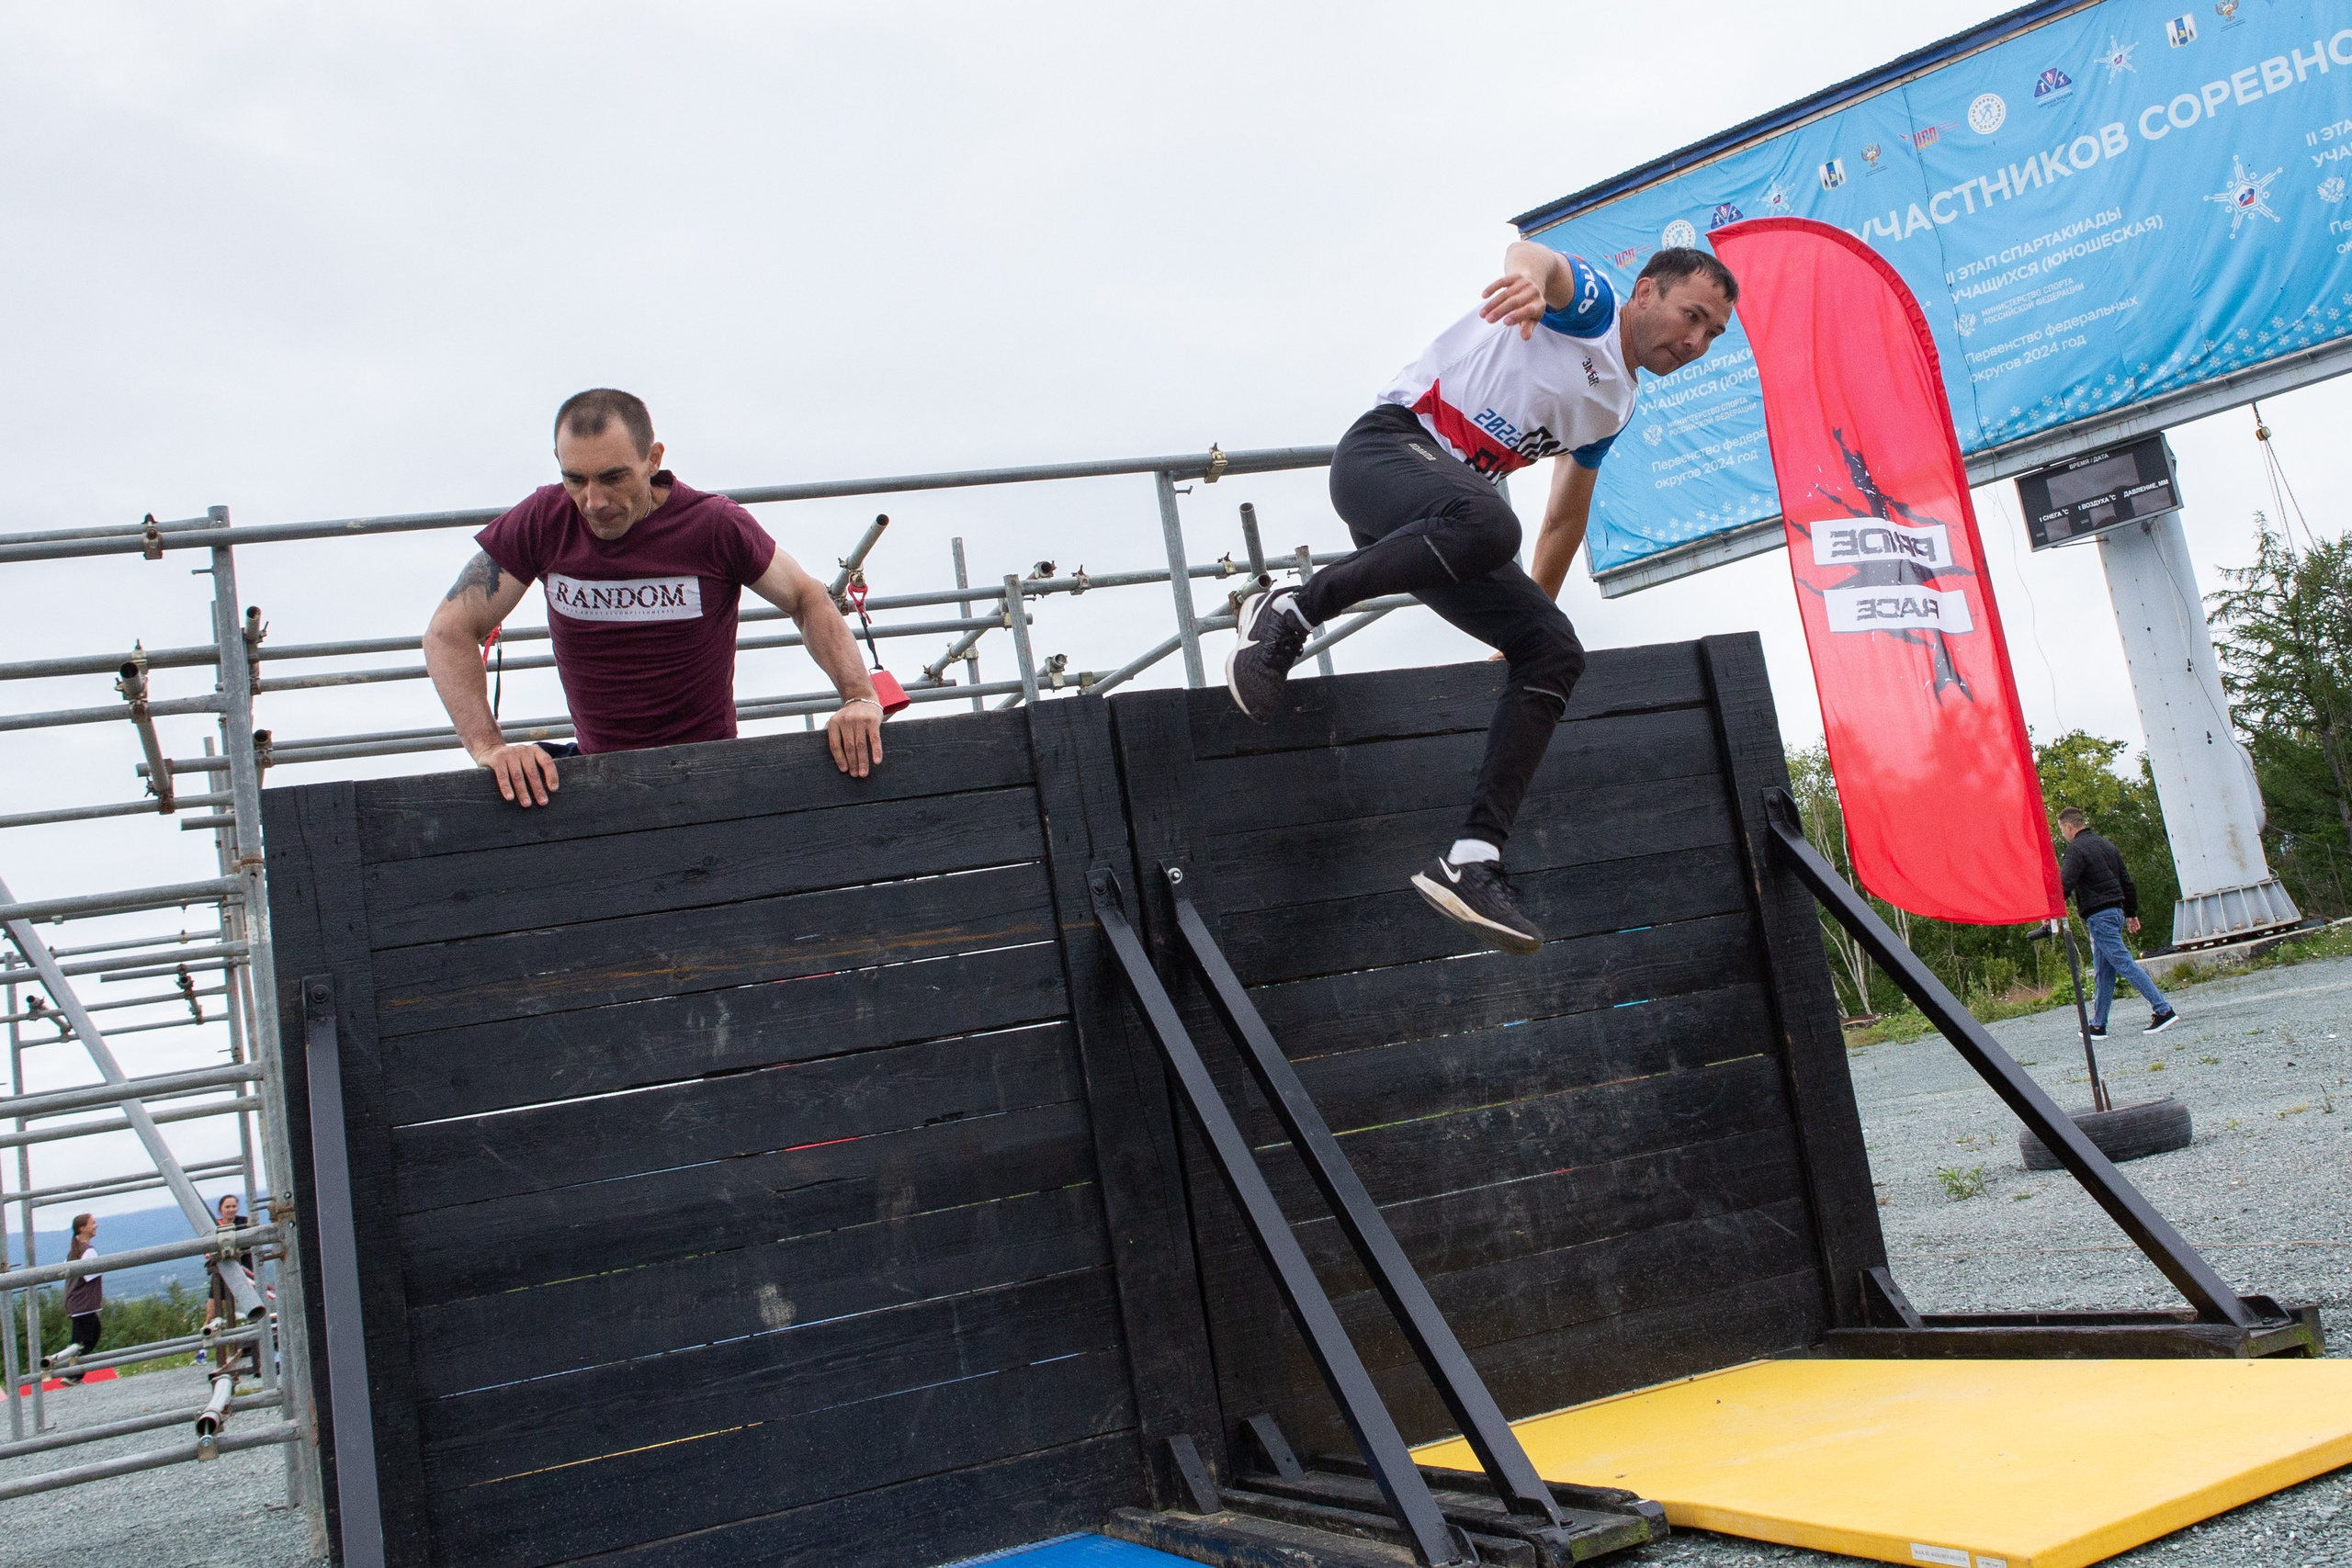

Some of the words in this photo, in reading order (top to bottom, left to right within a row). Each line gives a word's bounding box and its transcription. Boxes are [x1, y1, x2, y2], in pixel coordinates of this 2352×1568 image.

[2311, 142, 2352, 168] УЧА
[1951, 262, 2039, 304] УЧАЩИХСЯ
[2041, 214, 2164, 273] (ЮНОШЕСКАЯ)
[1958, 255, 1998, 280] ЭТАП
[2000, 206, 2122, 264] СПАРТАКИАДЫ
[1982, 288, 2041, 317] МИНИСТЕРСТВО
[2042, 277, 2074, 295] СПОРТА
[1984, 302, 2035, 325] РОССИЙСКОЙ
[2036, 282, 2085, 306] ФЕДЕРАЦИИ
[1964, 332, 2042, 365] Первенство
[2045, 295, 2139, 337] федеральных
[1970, 358, 2021, 385] округов
[2023, 344, 2059, 366] 2024
[2061, 334, 2086, 352] год
[1639, 380, 1717, 416] УЧАЩИХСЯ
[1645, 372, 1680, 394] ЭТАП
[1473, 408, 1522, 446] 2022
[1668, 406, 1720, 429] МИНИСТЕРСТВО
[1721, 397, 1747, 412] СПОРТА
[1714, 402, 1757, 422] ФЕДЕРАЦИИ
[1652, 444, 1721, 473] Первенство
[1655, 467, 1701, 490] округов
[1702, 457, 1735, 475] 2024
[1736, 449, 1759, 466] год
[2093, 453, 2109, 463] ДАТА
[2042, 511, 2063, 522] СНЕГА
[2081, 497, 2110, 510] ВОЗДУХА
[554, 581, 686, 609] RANDOM
